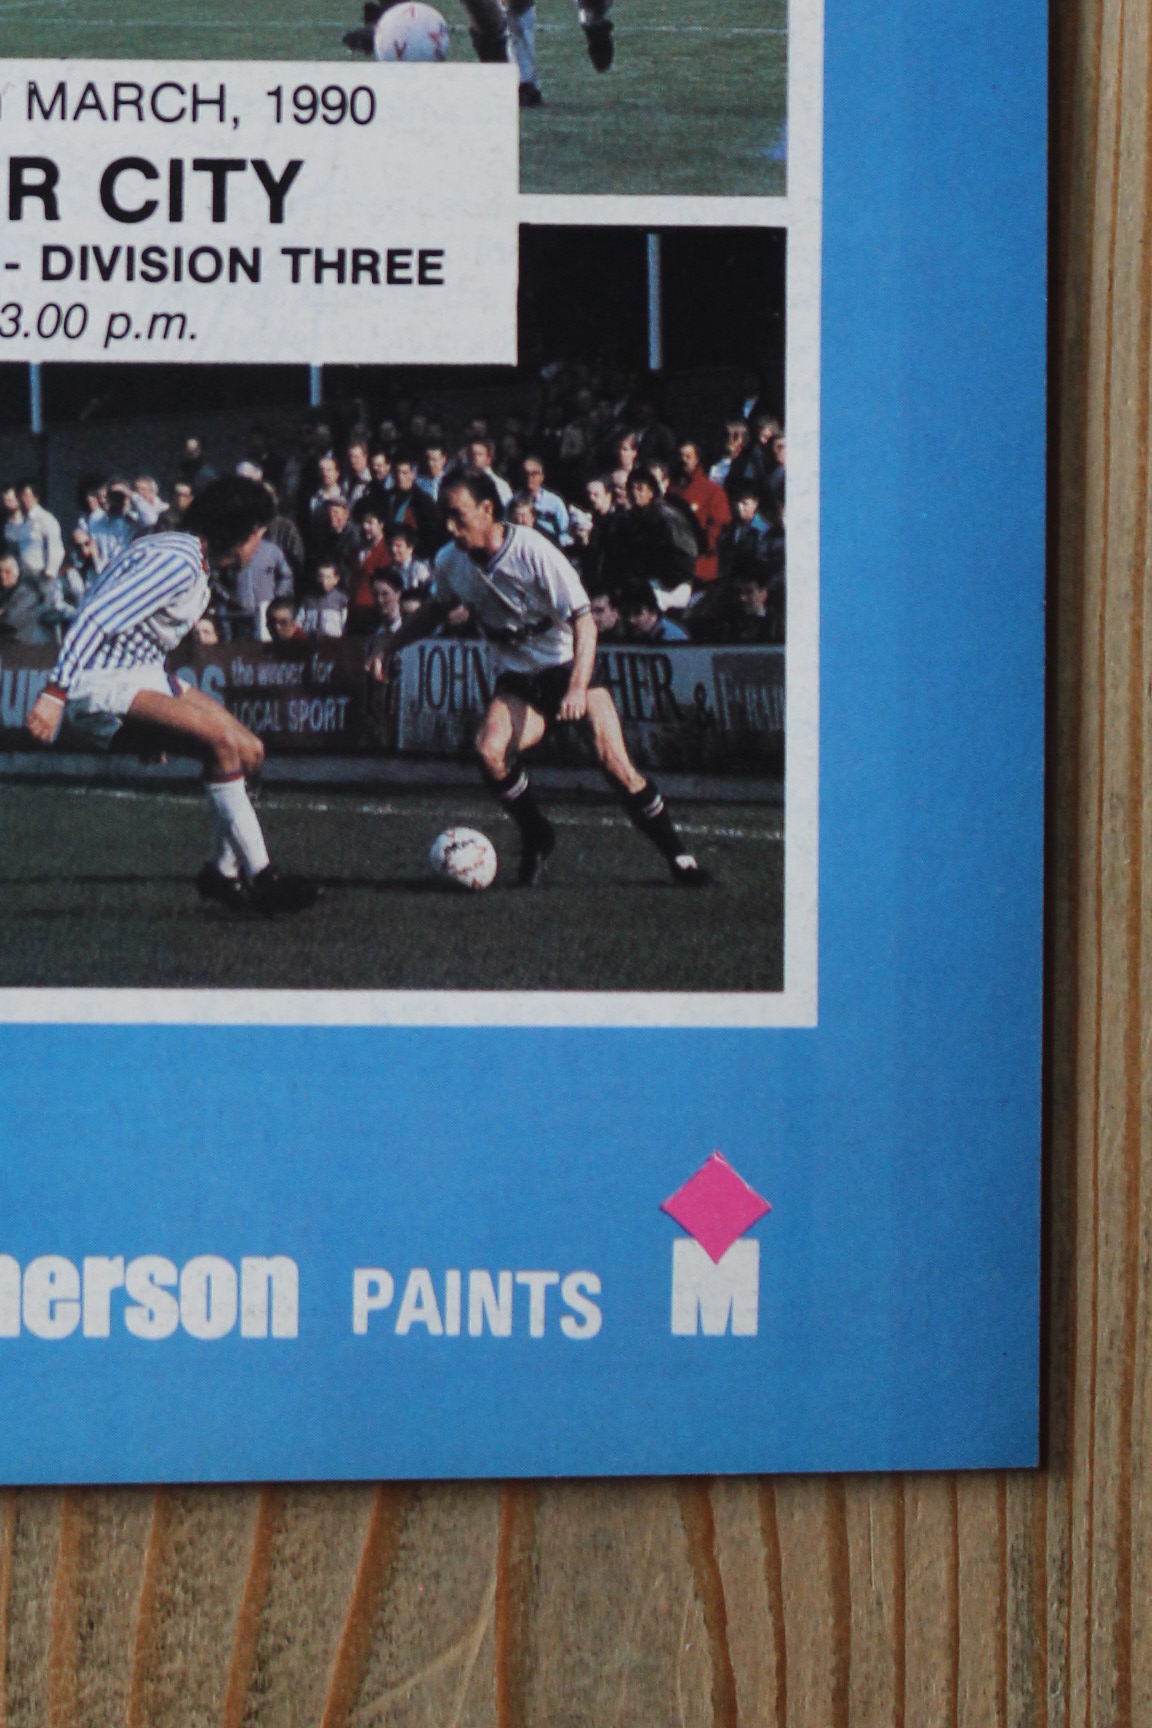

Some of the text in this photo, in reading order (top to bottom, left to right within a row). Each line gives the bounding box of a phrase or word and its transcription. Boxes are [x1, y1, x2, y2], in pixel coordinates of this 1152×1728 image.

[27, 80, 240, 130] MARCH,
[266, 84, 377, 126] 1990
[99, 156, 304, 224] CITY
[41, 244, 261, 284] DIVISION
[280, 247, 445, 286] THREE
[103, 312, 197, 349] p.m.
[287, 696, 349, 732] SPORT
[352, 1266, 603, 1340] PAINTS
